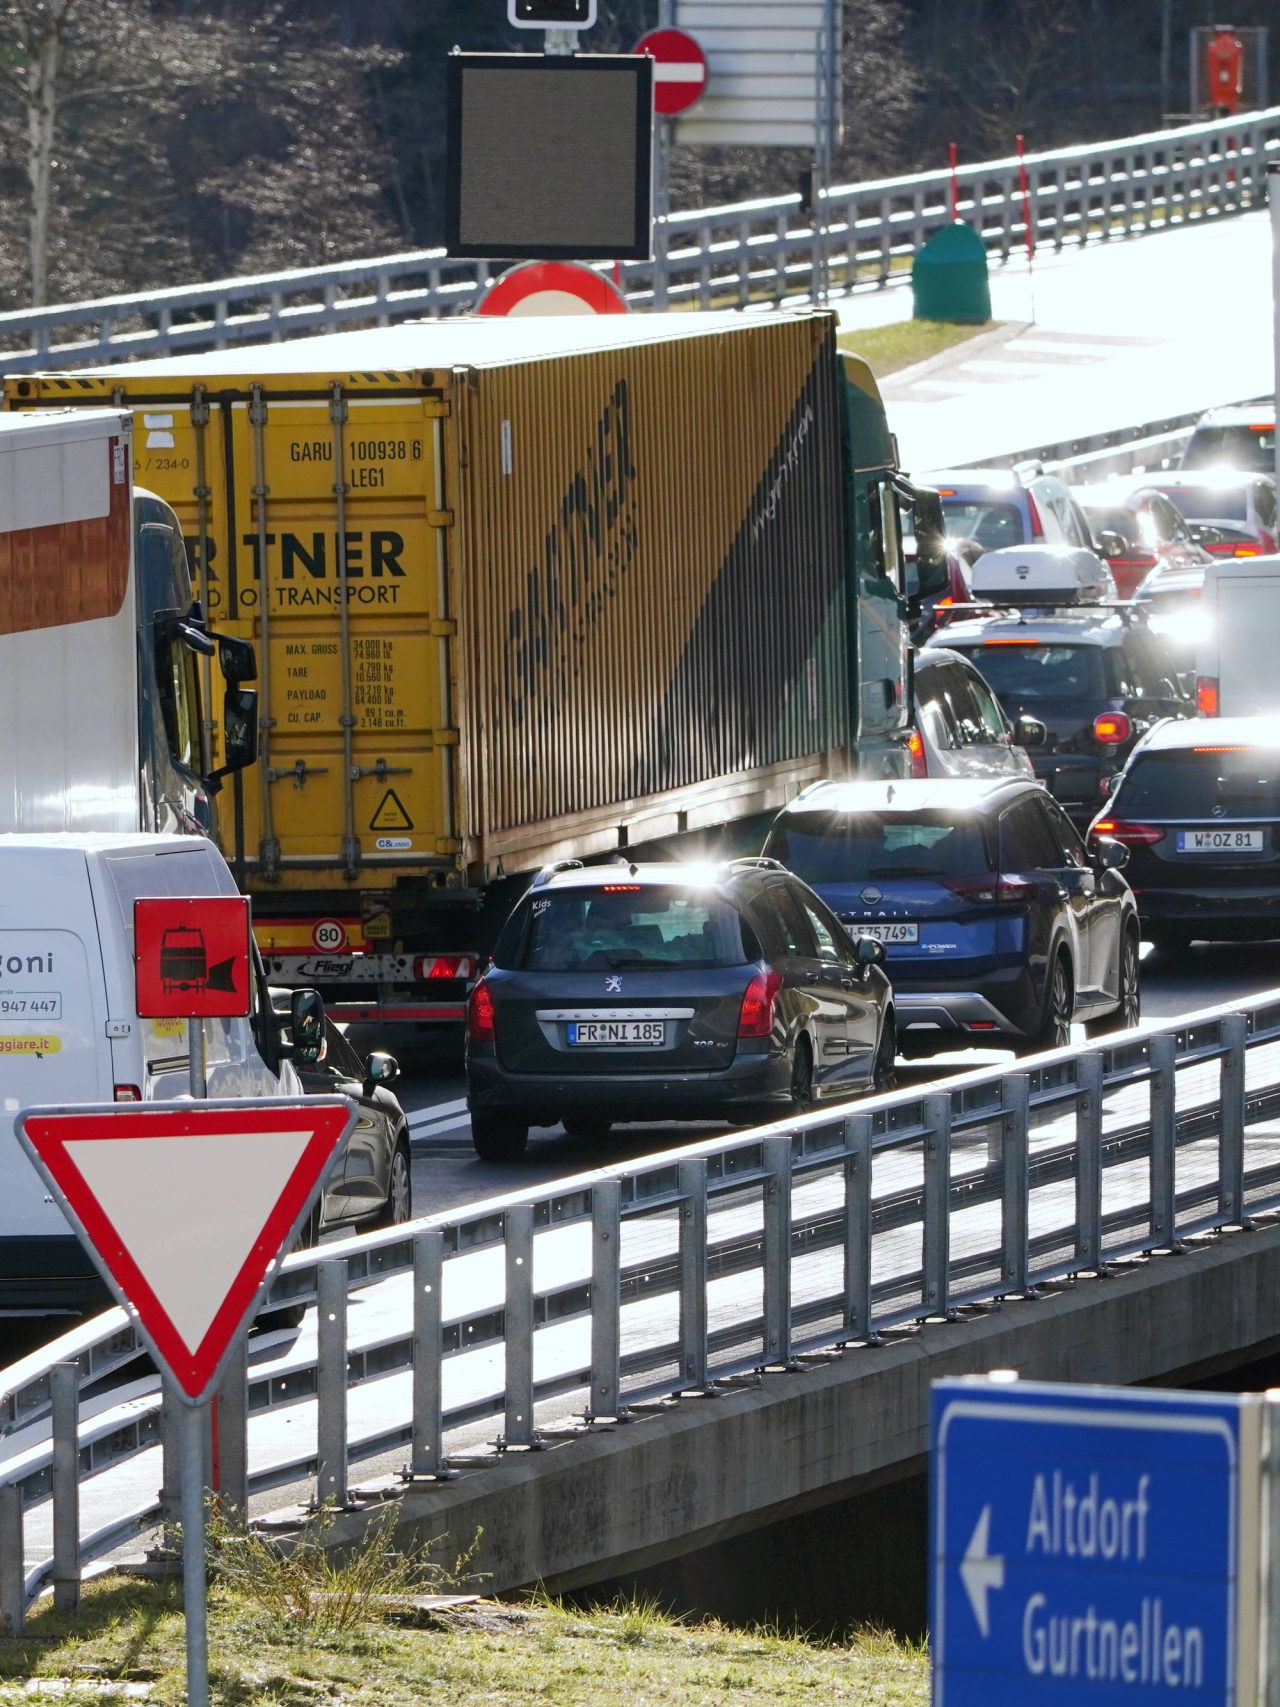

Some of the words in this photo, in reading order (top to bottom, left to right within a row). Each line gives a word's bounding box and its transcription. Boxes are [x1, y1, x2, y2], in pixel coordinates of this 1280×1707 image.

[291, 442, 332, 461] GARU
[350, 440, 406, 460] 100938
[276, 585, 400, 606] TRANSPORT
[312, 644, 338, 655] GROSS
[287, 667, 308, 678] TARE
[287, 690, 326, 701] PAYLOAD
[1195, 833, 1203, 847] W
[1235, 833, 1252, 847] 81
[532, 900, 552, 910] Kids
[319, 928, 339, 942] 80
[314, 960, 354, 975] Fliegl
[1, 1001, 27, 1012] 947
[30, 1000, 57, 1012] 447
[578, 1025, 597, 1041] FR
[608, 1025, 627, 1040] NI
[633, 1024, 663, 1040] 185
[1026, 1468, 1150, 1561] Altdorf
[1023, 1592, 1204, 1688] Gurtnellen
